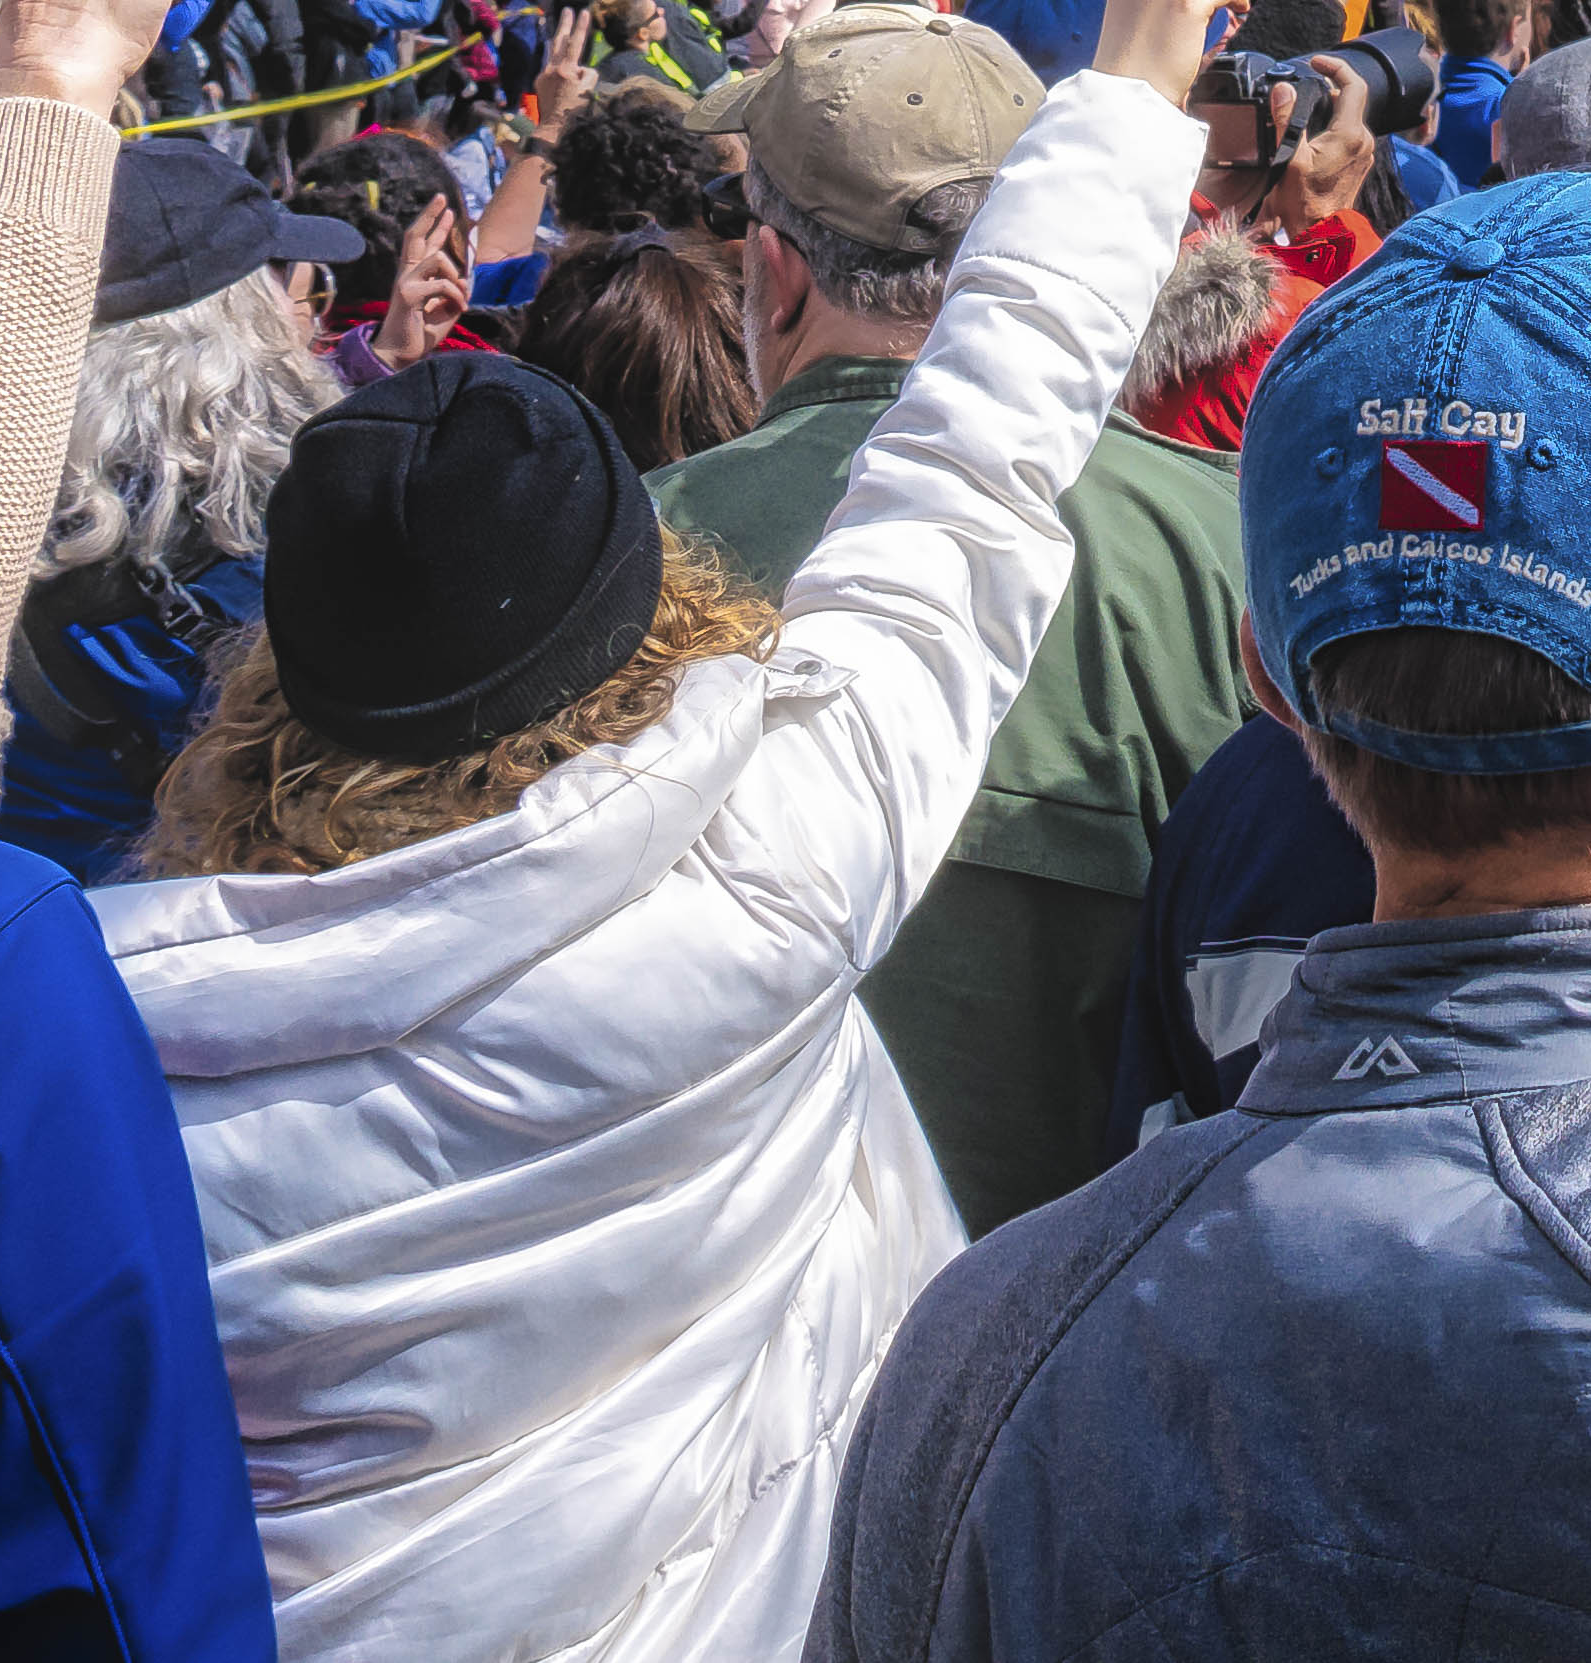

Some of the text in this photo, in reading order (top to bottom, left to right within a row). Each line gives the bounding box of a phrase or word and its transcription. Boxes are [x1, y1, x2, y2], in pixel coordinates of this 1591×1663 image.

[1357, 398, 1526, 450] Salt Cay
[1289, 553, 1343, 600] Turks
[1342, 533, 1394, 566] and
[1400, 534, 1494, 566] Caicos
